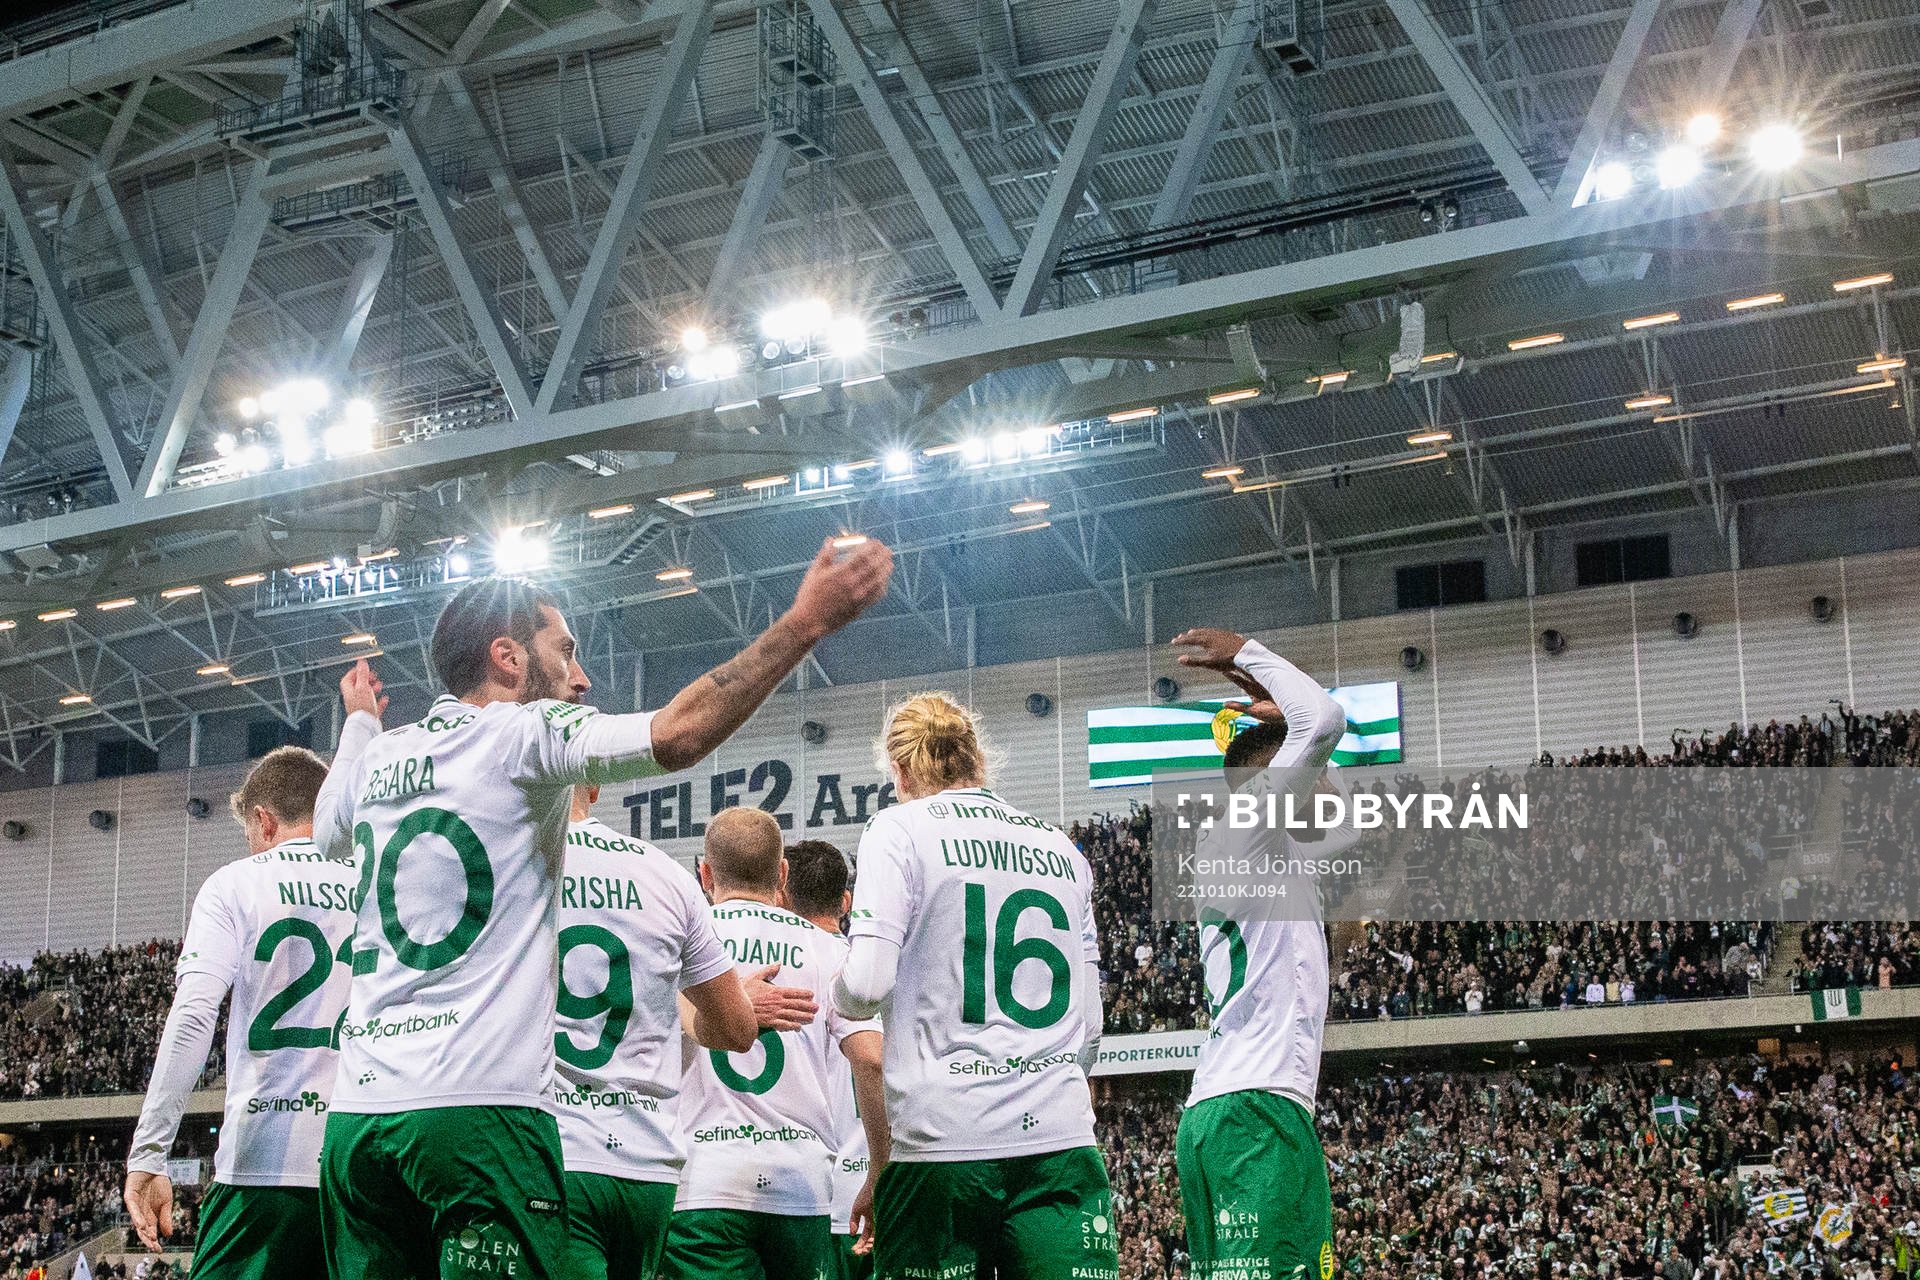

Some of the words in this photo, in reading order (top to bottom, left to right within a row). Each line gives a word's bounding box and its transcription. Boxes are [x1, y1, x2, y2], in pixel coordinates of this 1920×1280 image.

[623, 759, 793, 840] TELE2
[940, 838, 1077, 883] LUDWIGSON
[962, 882, 1071, 1029] 16
[373, 1009, 459, 1043] pantbank
[949, 1060, 1011, 1075] Sefina
[247, 1096, 304, 1114] Sefina
